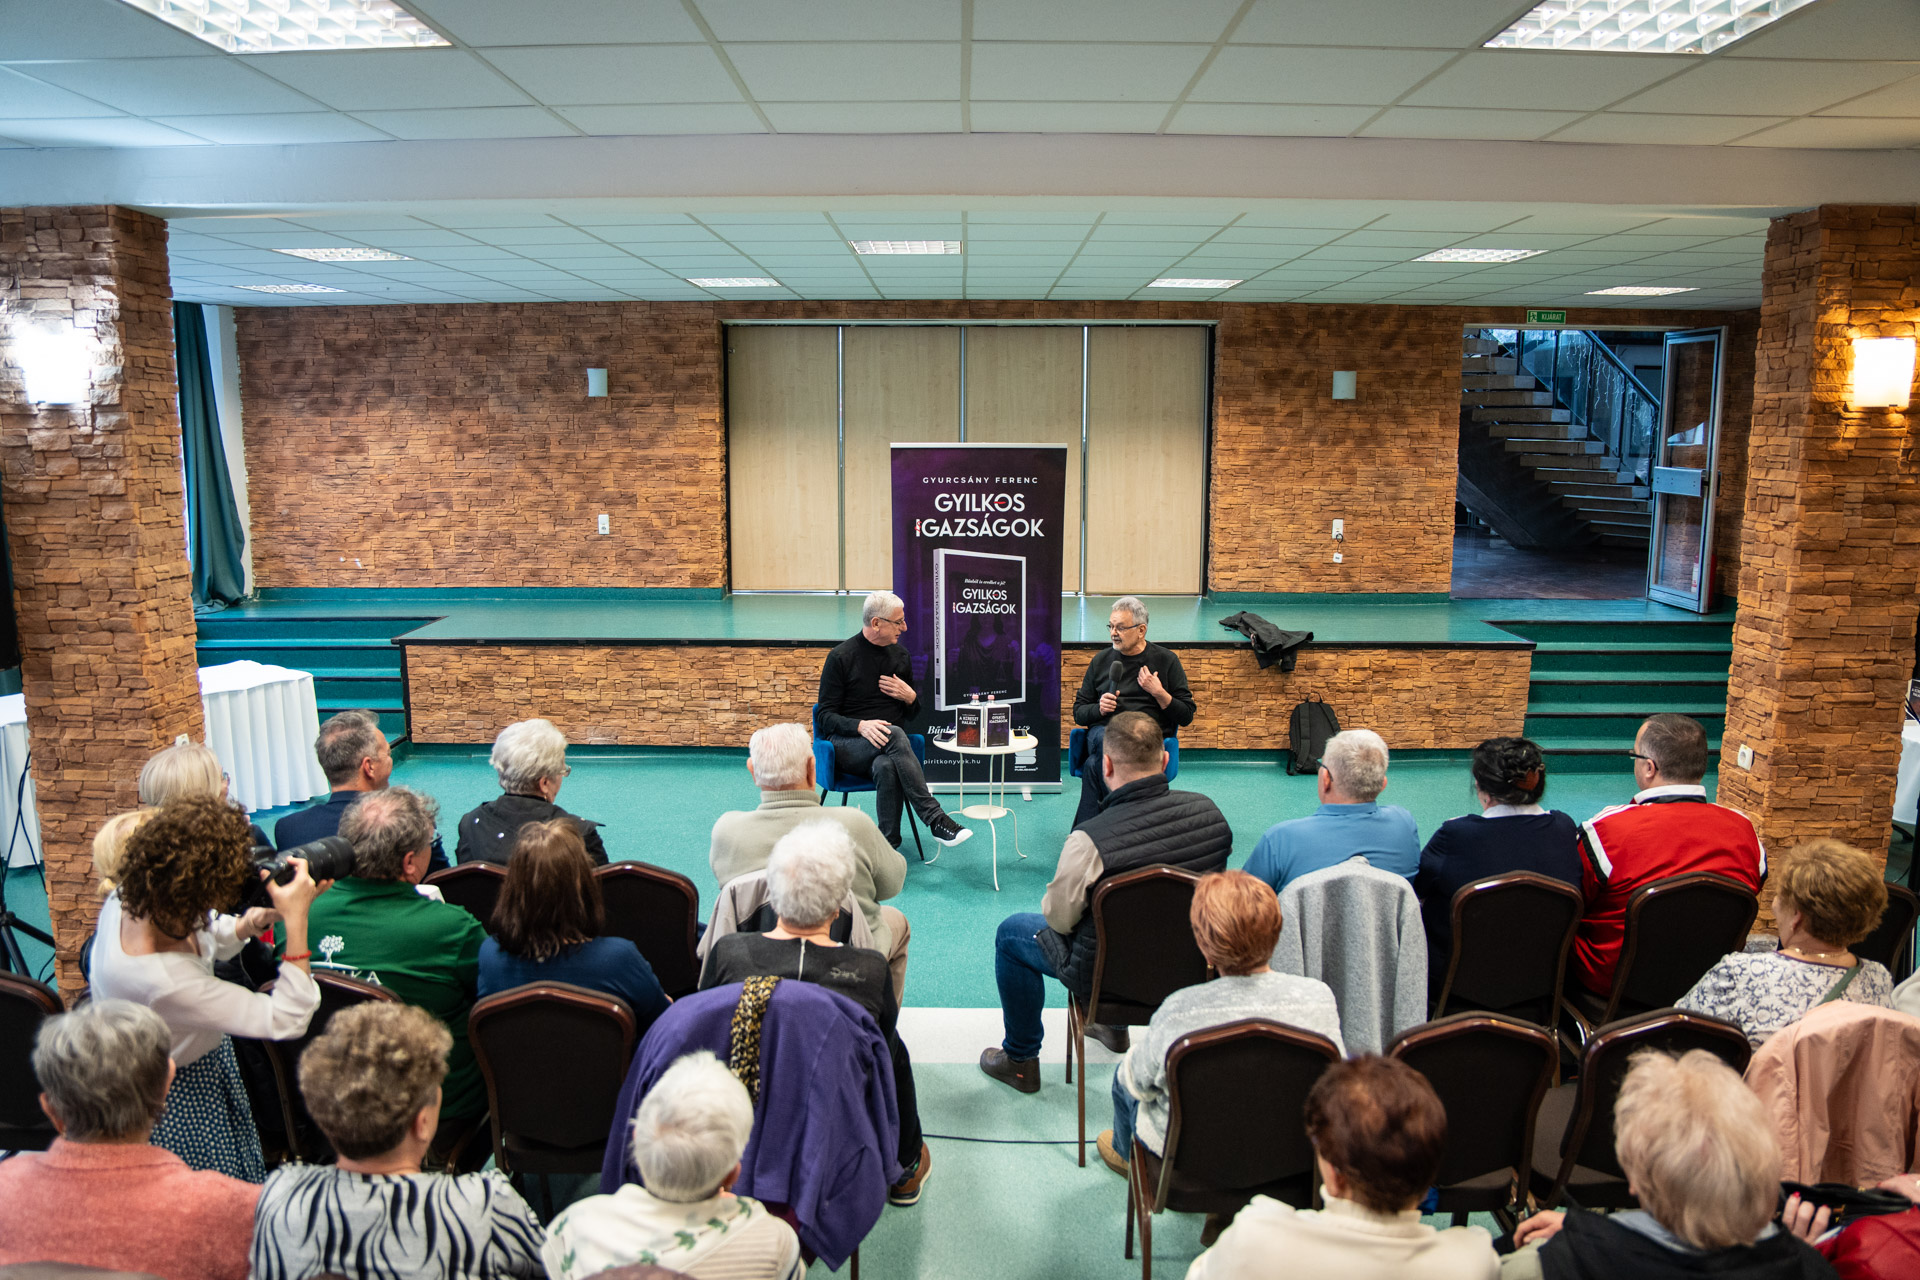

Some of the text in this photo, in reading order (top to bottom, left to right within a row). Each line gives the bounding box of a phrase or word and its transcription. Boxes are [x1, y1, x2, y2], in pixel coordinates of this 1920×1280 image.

[922, 476, 990, 484] GYURCSÁNY
[934, 493, 1026, 512] GYILKOS
[914, 513, 1045, 537] IGAZSÁGOK
[963, 588, 1008, 600] GYILKOS
[952, 600, 1016, 615] IGAZSÁGOK
